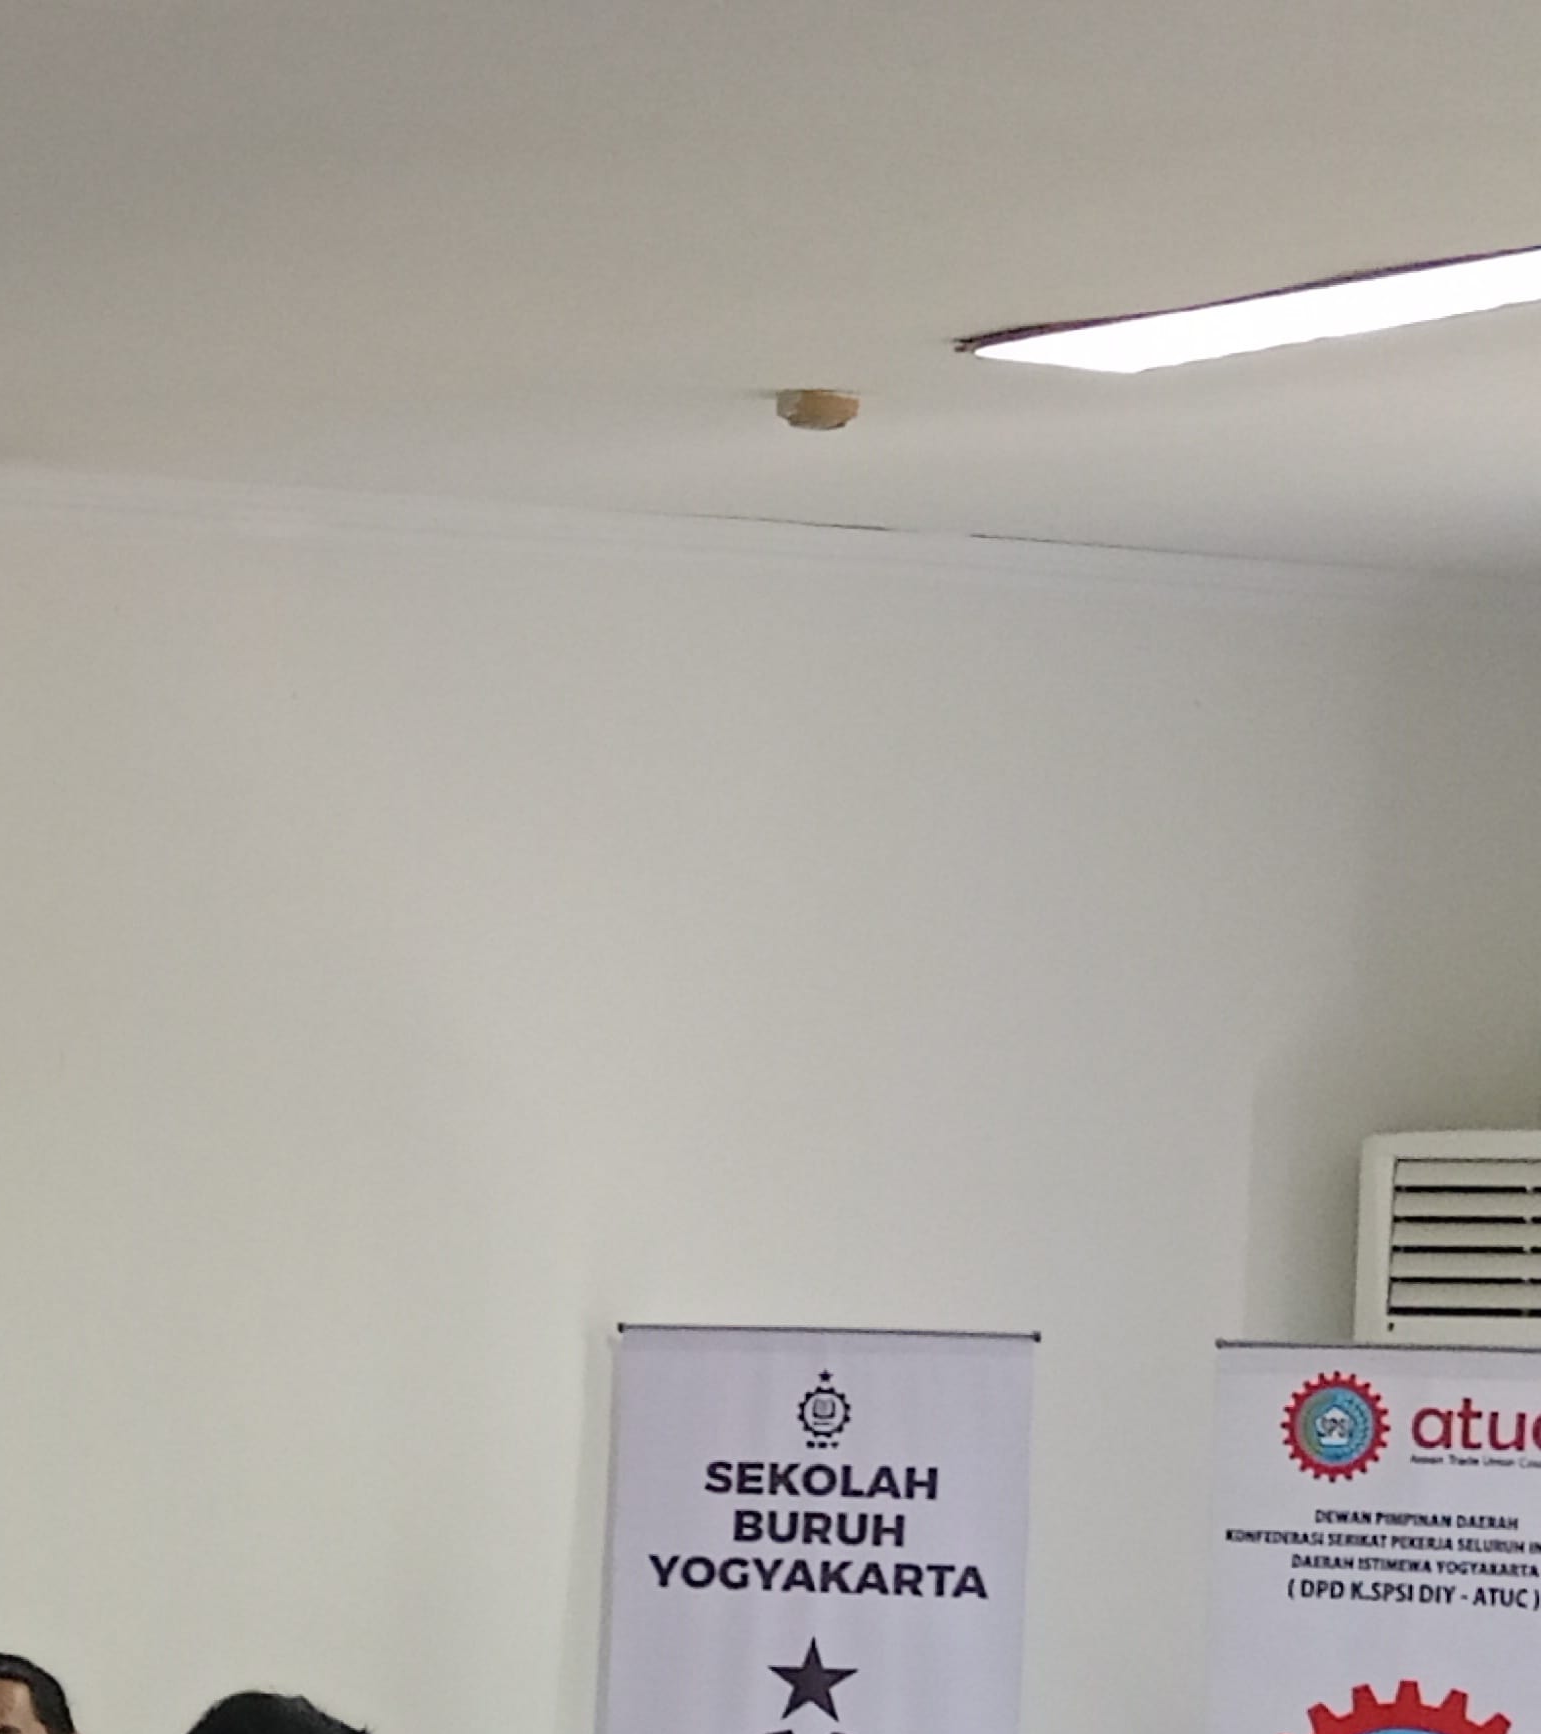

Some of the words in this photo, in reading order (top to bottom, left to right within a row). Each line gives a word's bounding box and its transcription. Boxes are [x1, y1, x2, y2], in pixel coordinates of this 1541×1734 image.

[1412, 1397, 1541, 1451] atu
[704, 1462, 938, 1500] SEKOLAH
[733, 1510, 905, 1547] BURUH
[649, 1555, 988, 1599] YOGYAKARTA
[1419, 1583, 1456, 1605] DIY
